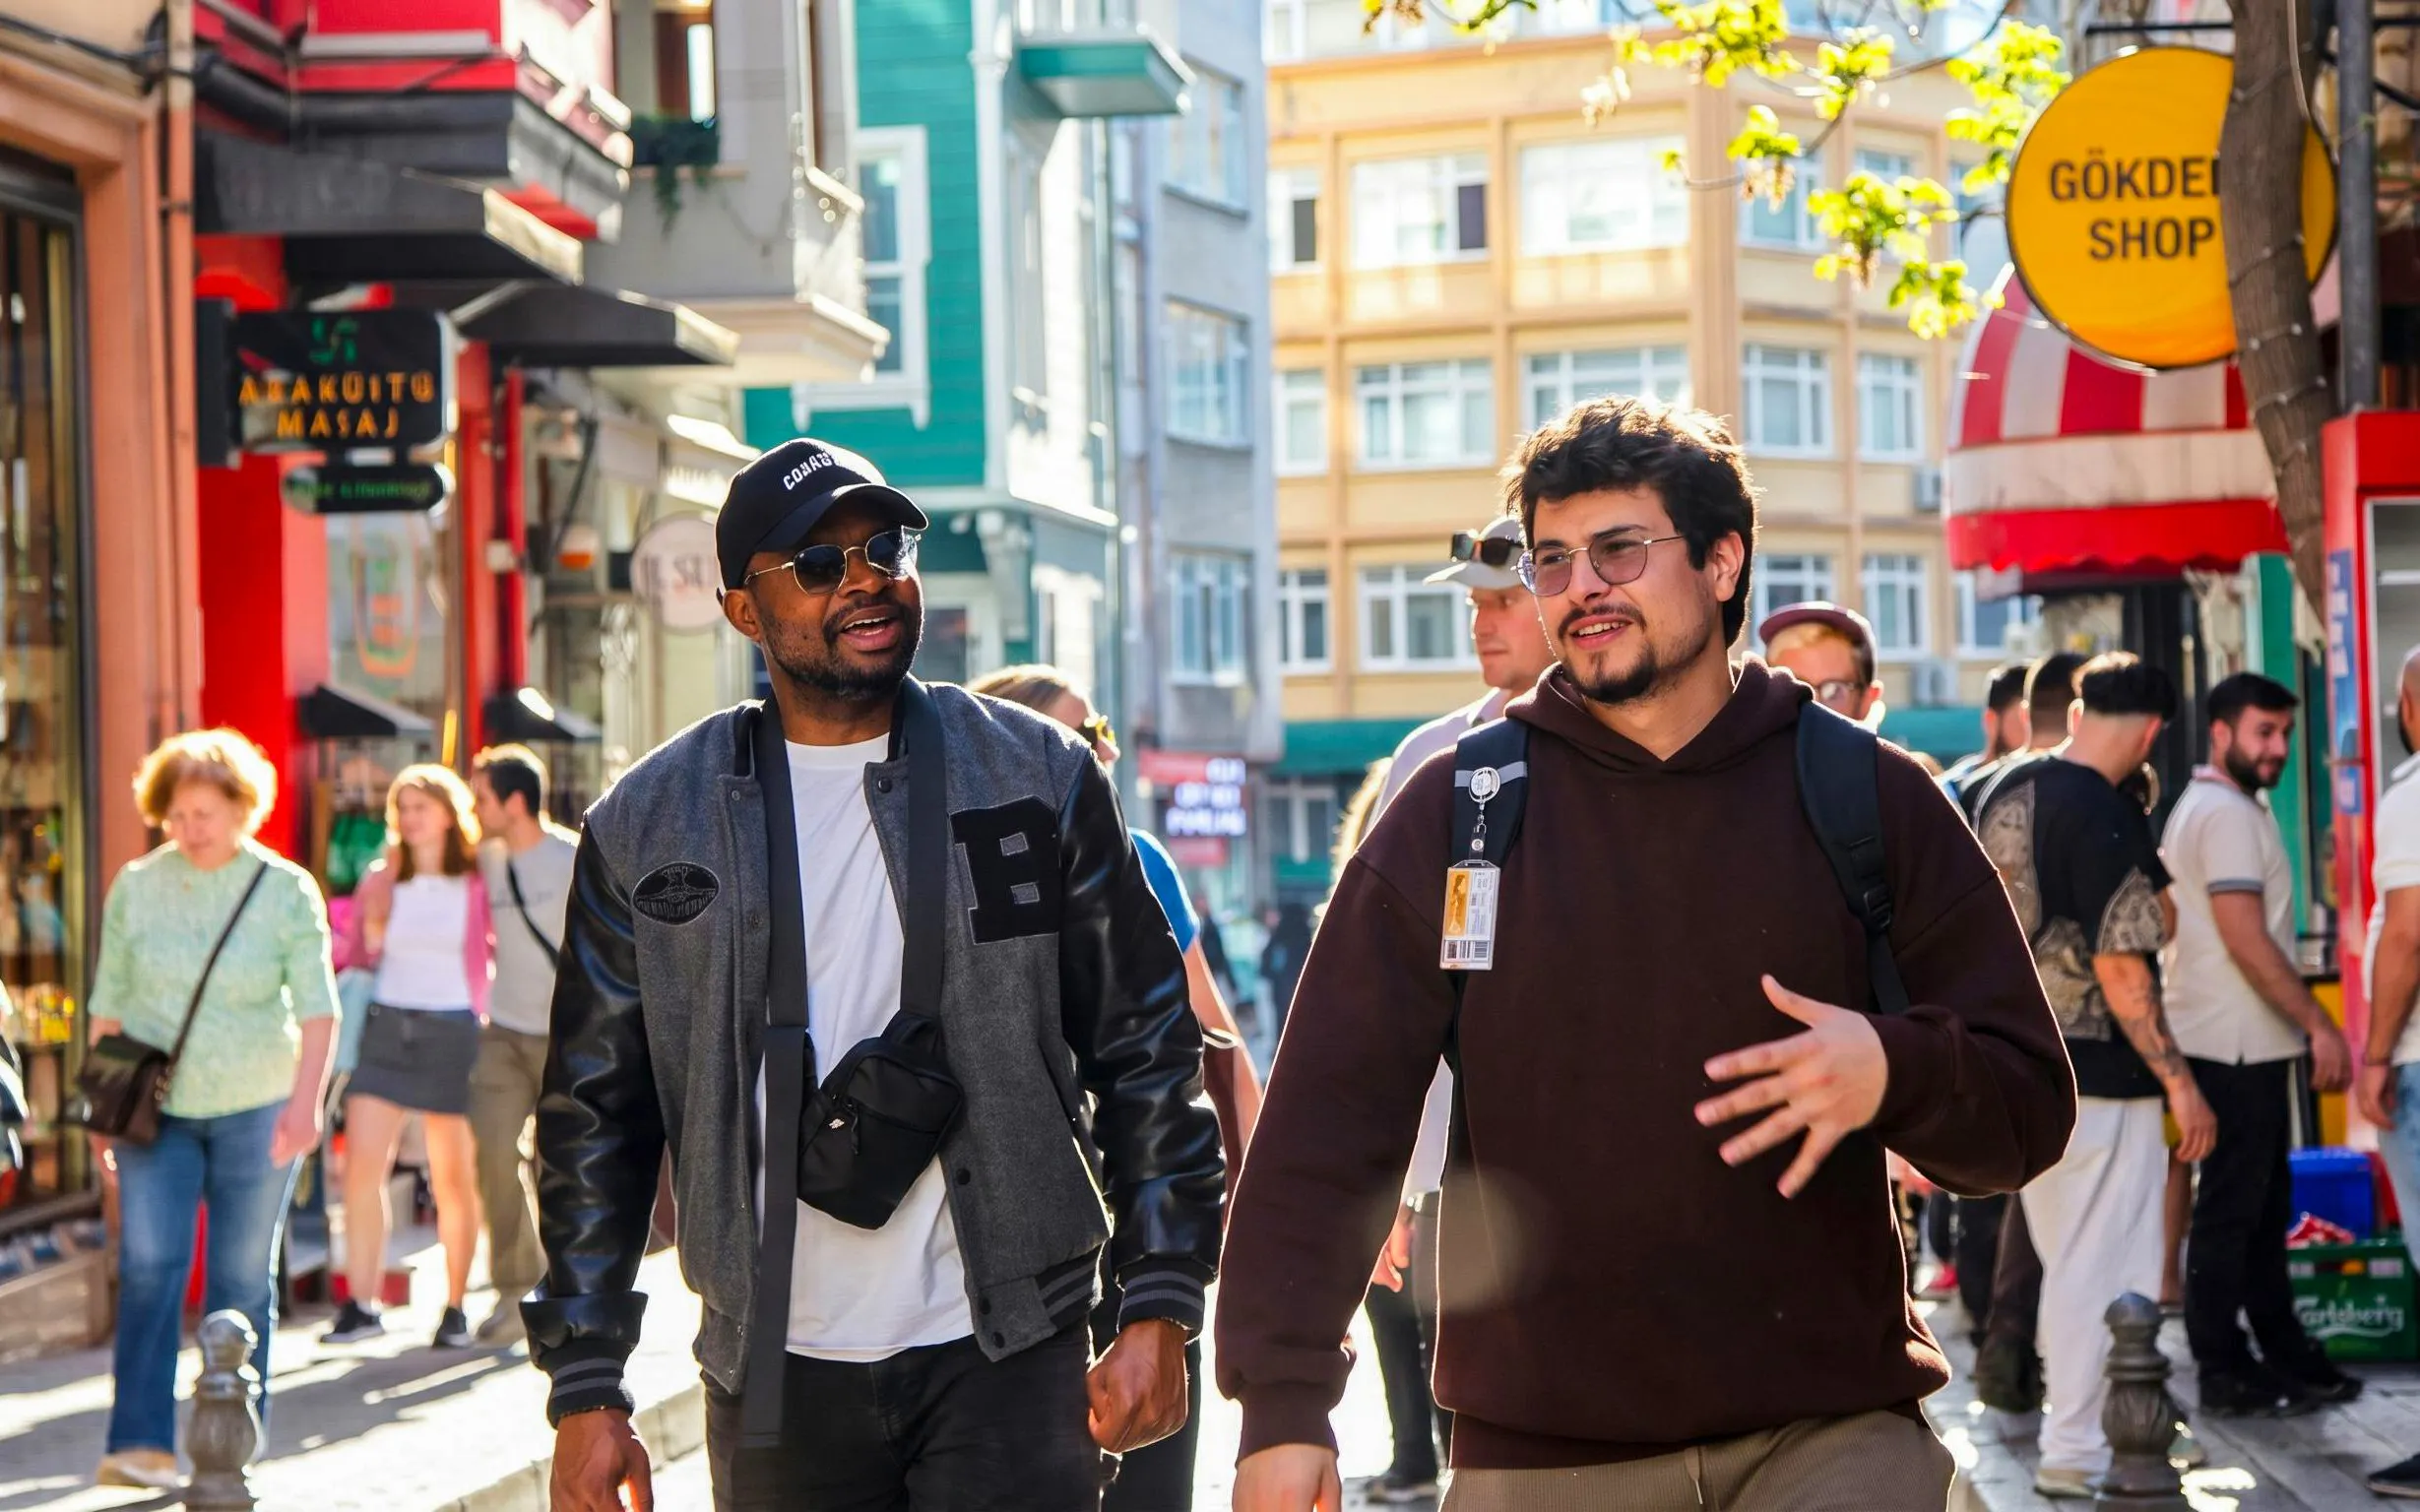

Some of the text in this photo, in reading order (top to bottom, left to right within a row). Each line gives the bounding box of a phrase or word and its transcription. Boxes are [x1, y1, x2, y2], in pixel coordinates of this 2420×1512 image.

[2089, 218, 2214, 261] SHOP
[277, 407, 399, 439] MASAJ
[947, 794, 1060, 945] B
